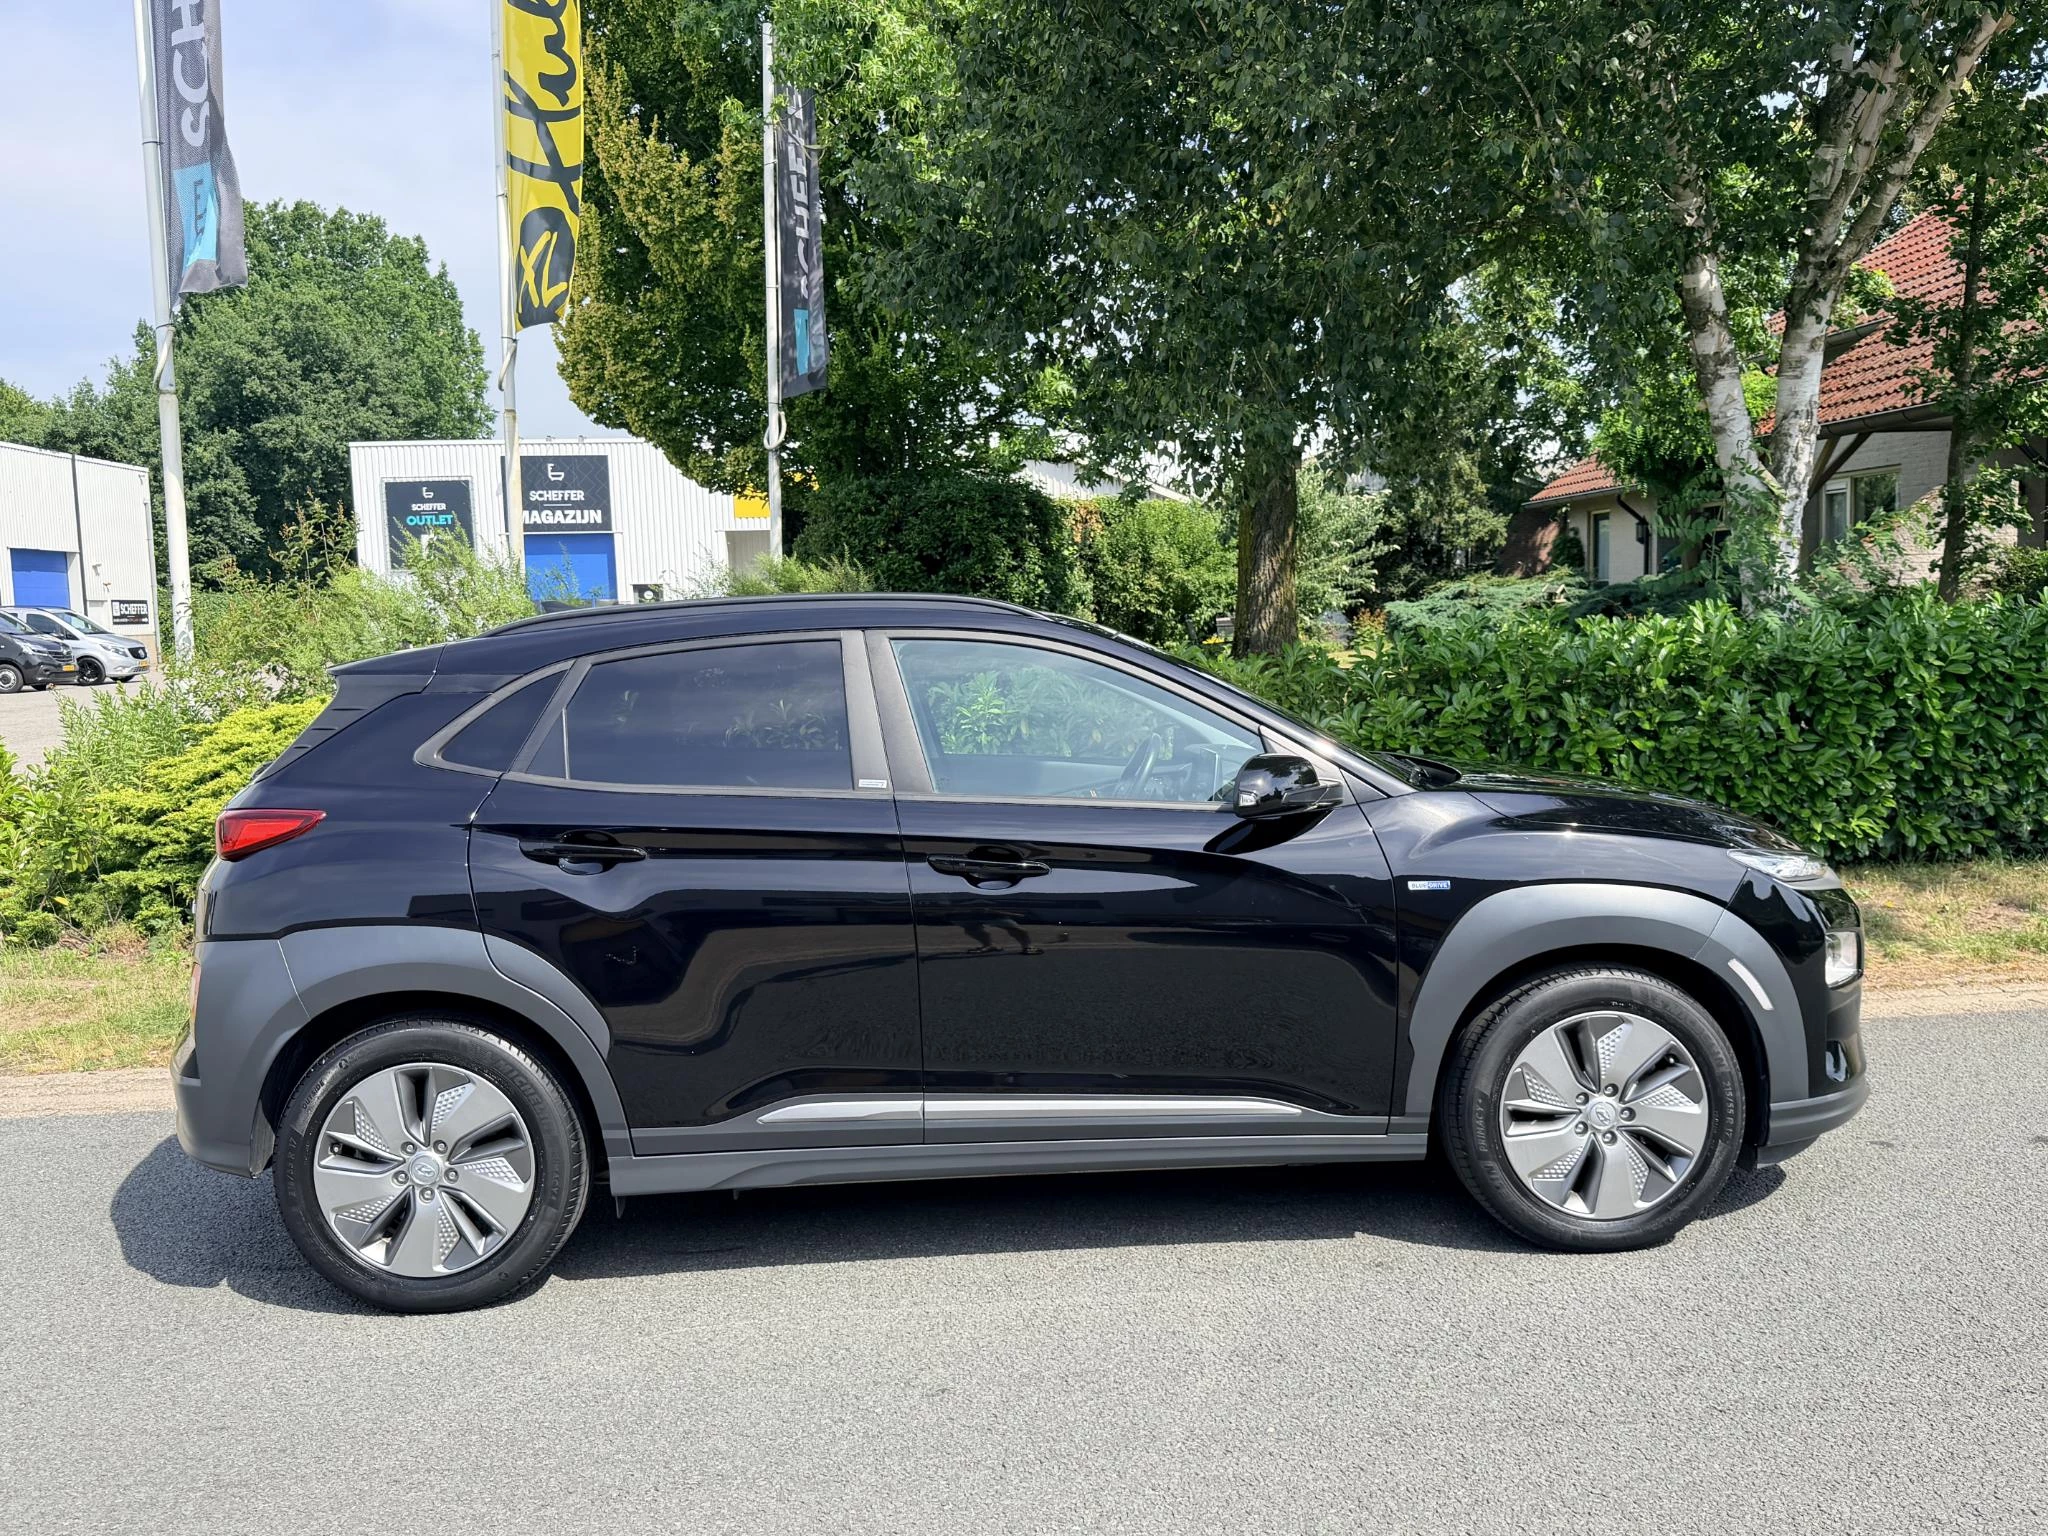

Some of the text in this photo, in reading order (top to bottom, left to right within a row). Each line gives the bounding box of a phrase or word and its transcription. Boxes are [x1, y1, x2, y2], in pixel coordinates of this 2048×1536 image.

[518, 230, 568, 314] XL
[529, 490, 585, 501] SCHEFFER
[411, 503, 447, 511] SCHEFFER
[406, 515, 453, 526] OUTLET
